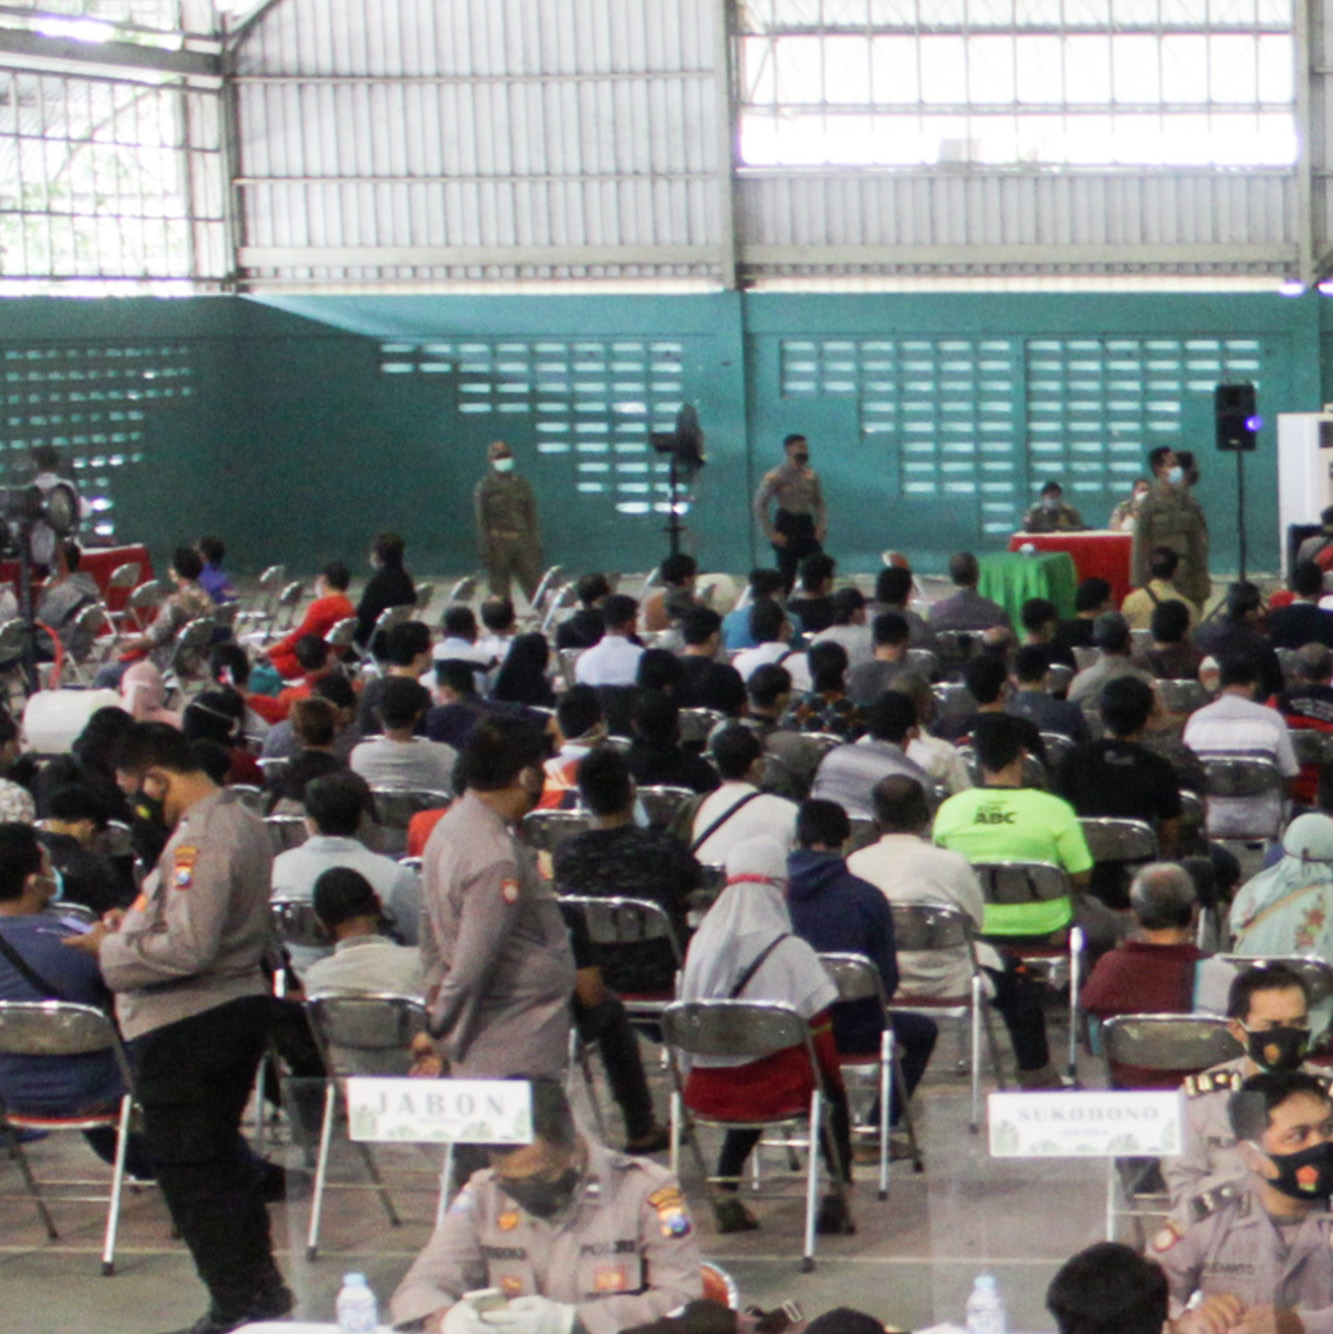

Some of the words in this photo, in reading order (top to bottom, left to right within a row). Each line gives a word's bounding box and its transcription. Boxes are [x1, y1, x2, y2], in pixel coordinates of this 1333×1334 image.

[974, 812, 1018, 825] ABC
[377, 1091, 505, 1117] JABON
[1017, 1106, 1159, 1122] SUKODONO
